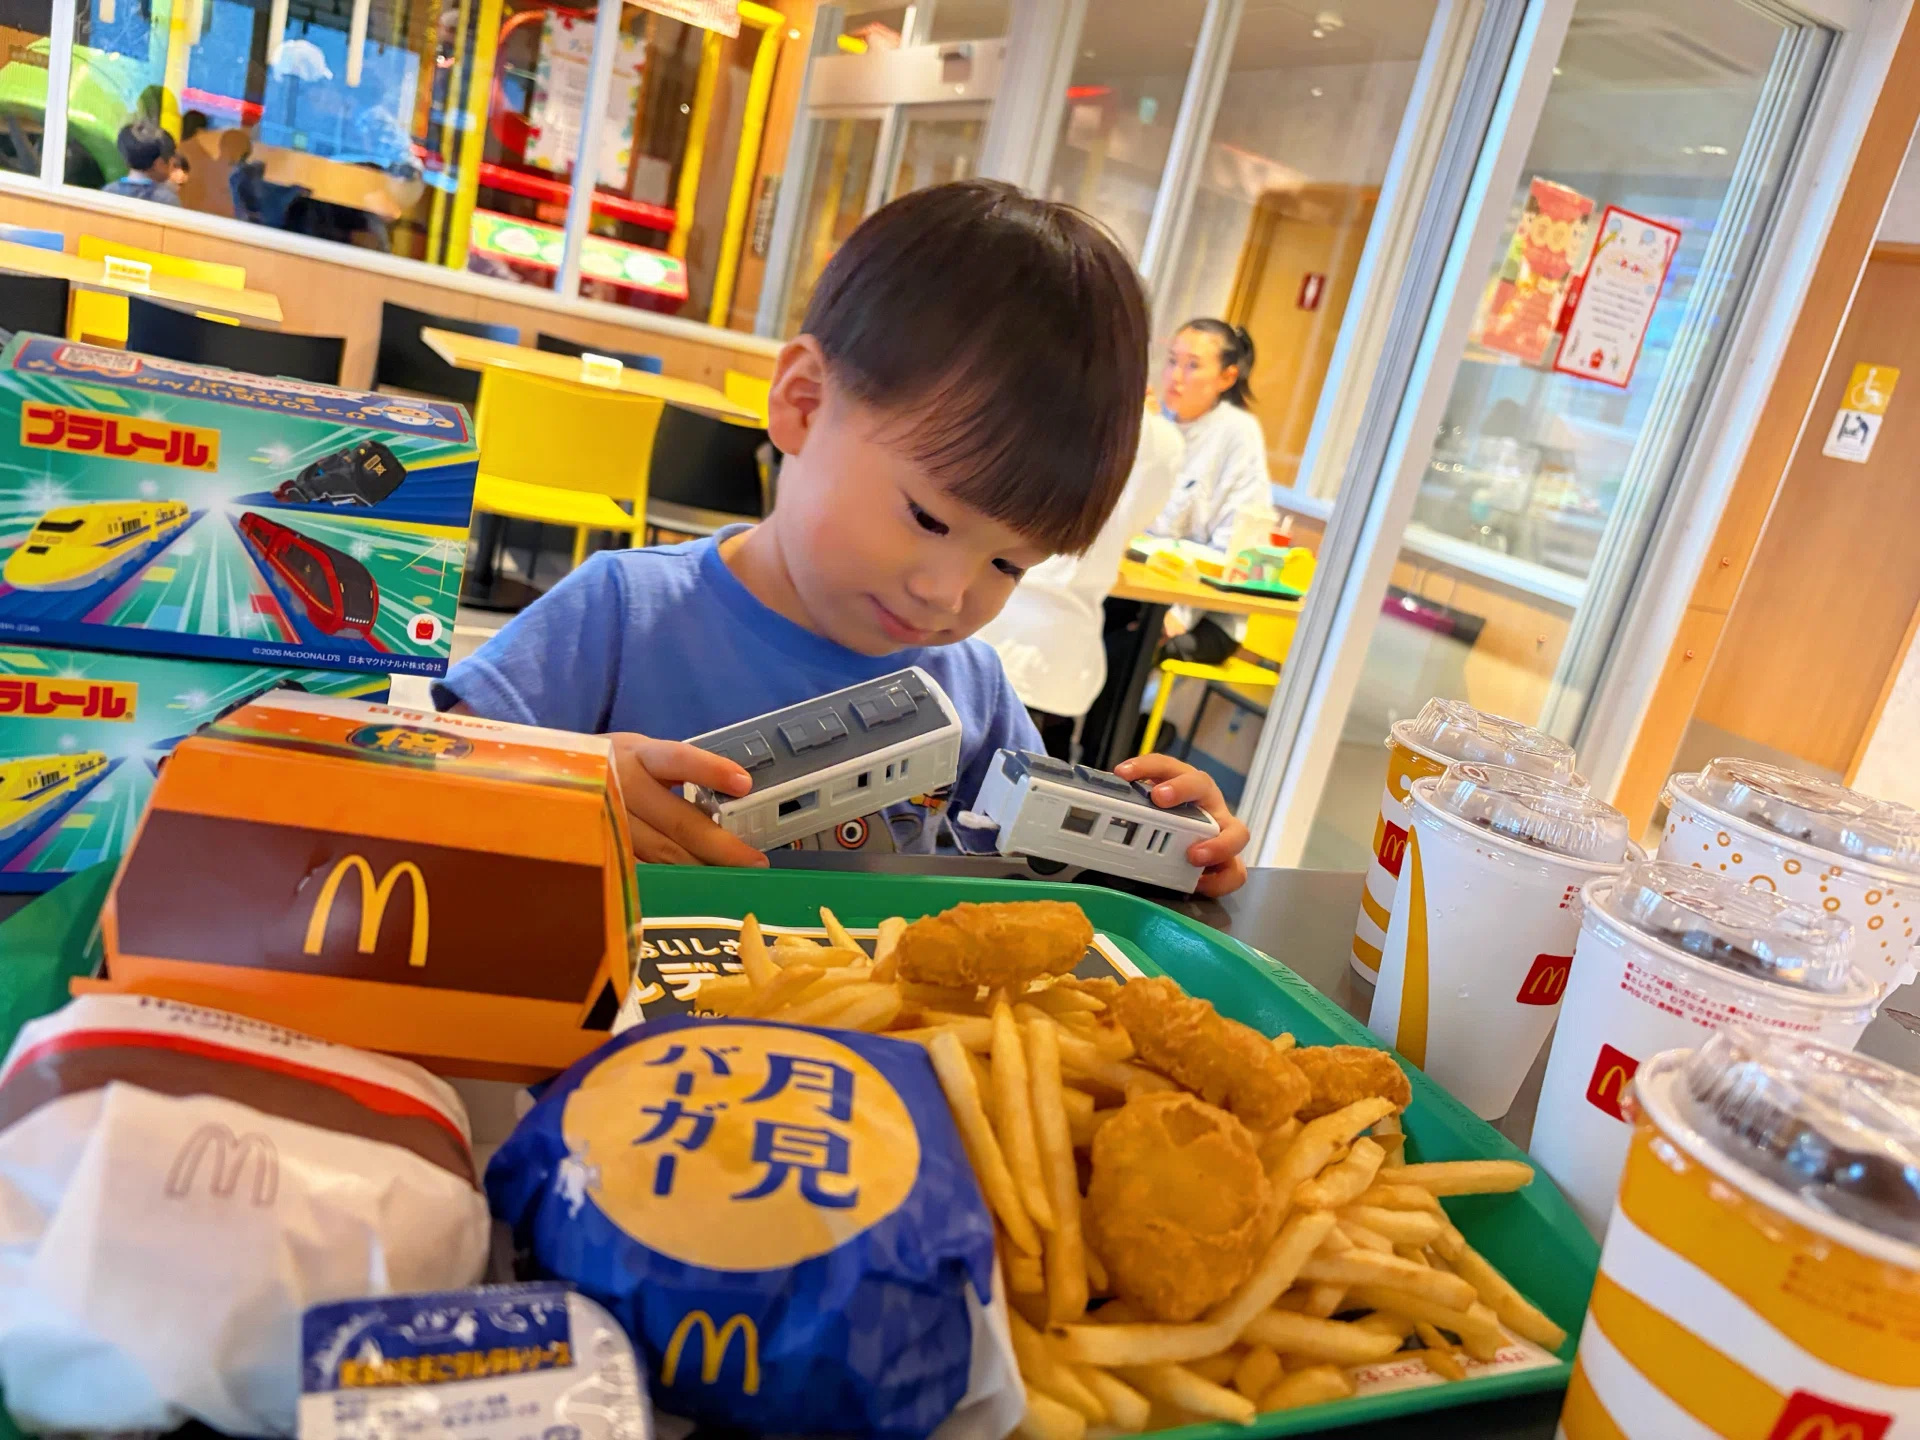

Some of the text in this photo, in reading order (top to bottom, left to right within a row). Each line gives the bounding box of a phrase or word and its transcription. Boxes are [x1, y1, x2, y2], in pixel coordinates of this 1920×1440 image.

[27, 409, 210, 468] プラレール
[283, 649, 341, 663] McDONALD'S
[347, 655, 443, 674] 日本マクドナルド株式会社
[368, 705, 508, 731] Big Mac
[633, 1044, 742, 1196] バーガー
[731, 1051, 860, 1209] 月見
